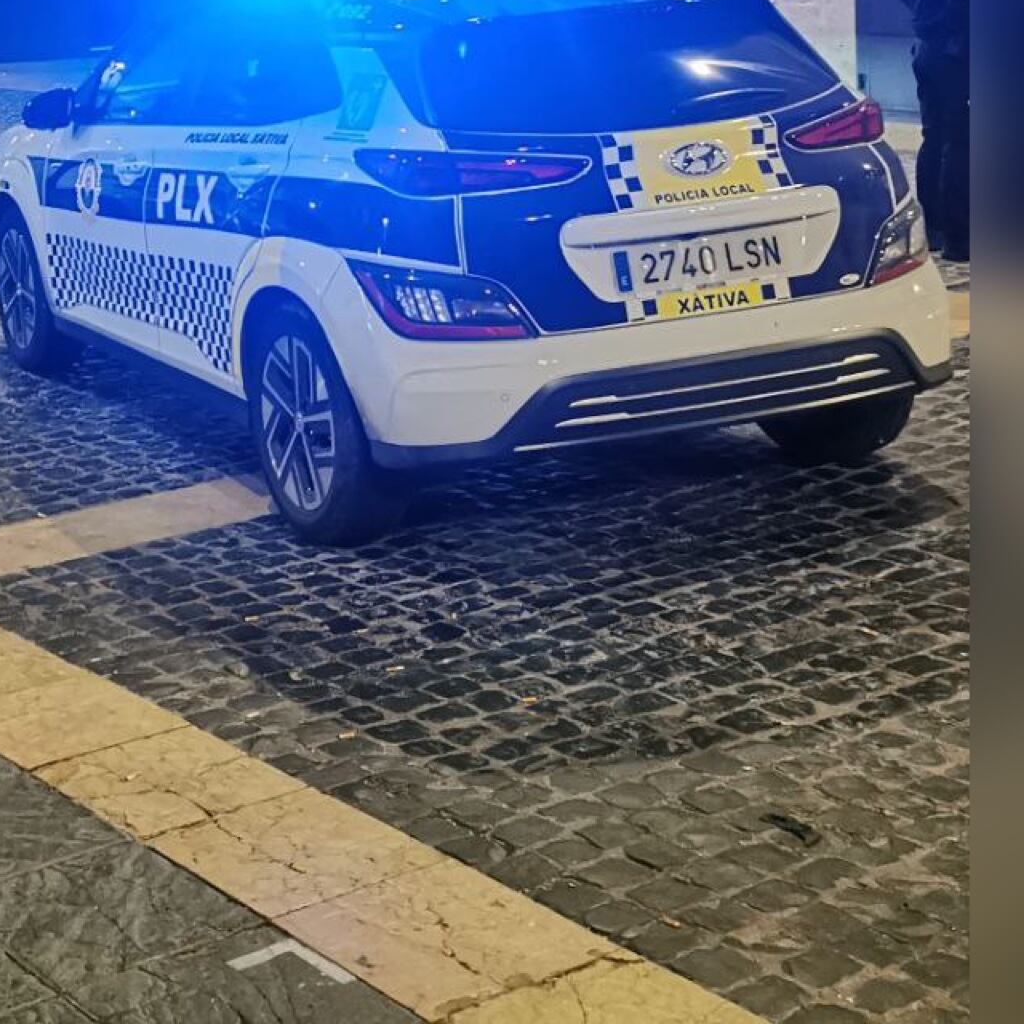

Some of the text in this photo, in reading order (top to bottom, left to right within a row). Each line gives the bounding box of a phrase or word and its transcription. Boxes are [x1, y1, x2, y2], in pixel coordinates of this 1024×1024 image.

[219, 133, 249, 144] LOCAL
[156, 172, 219, 225] PLX
[712, 184, 755, 197] LOCAL
[640, 236, 781, 284] 2740 LSN
